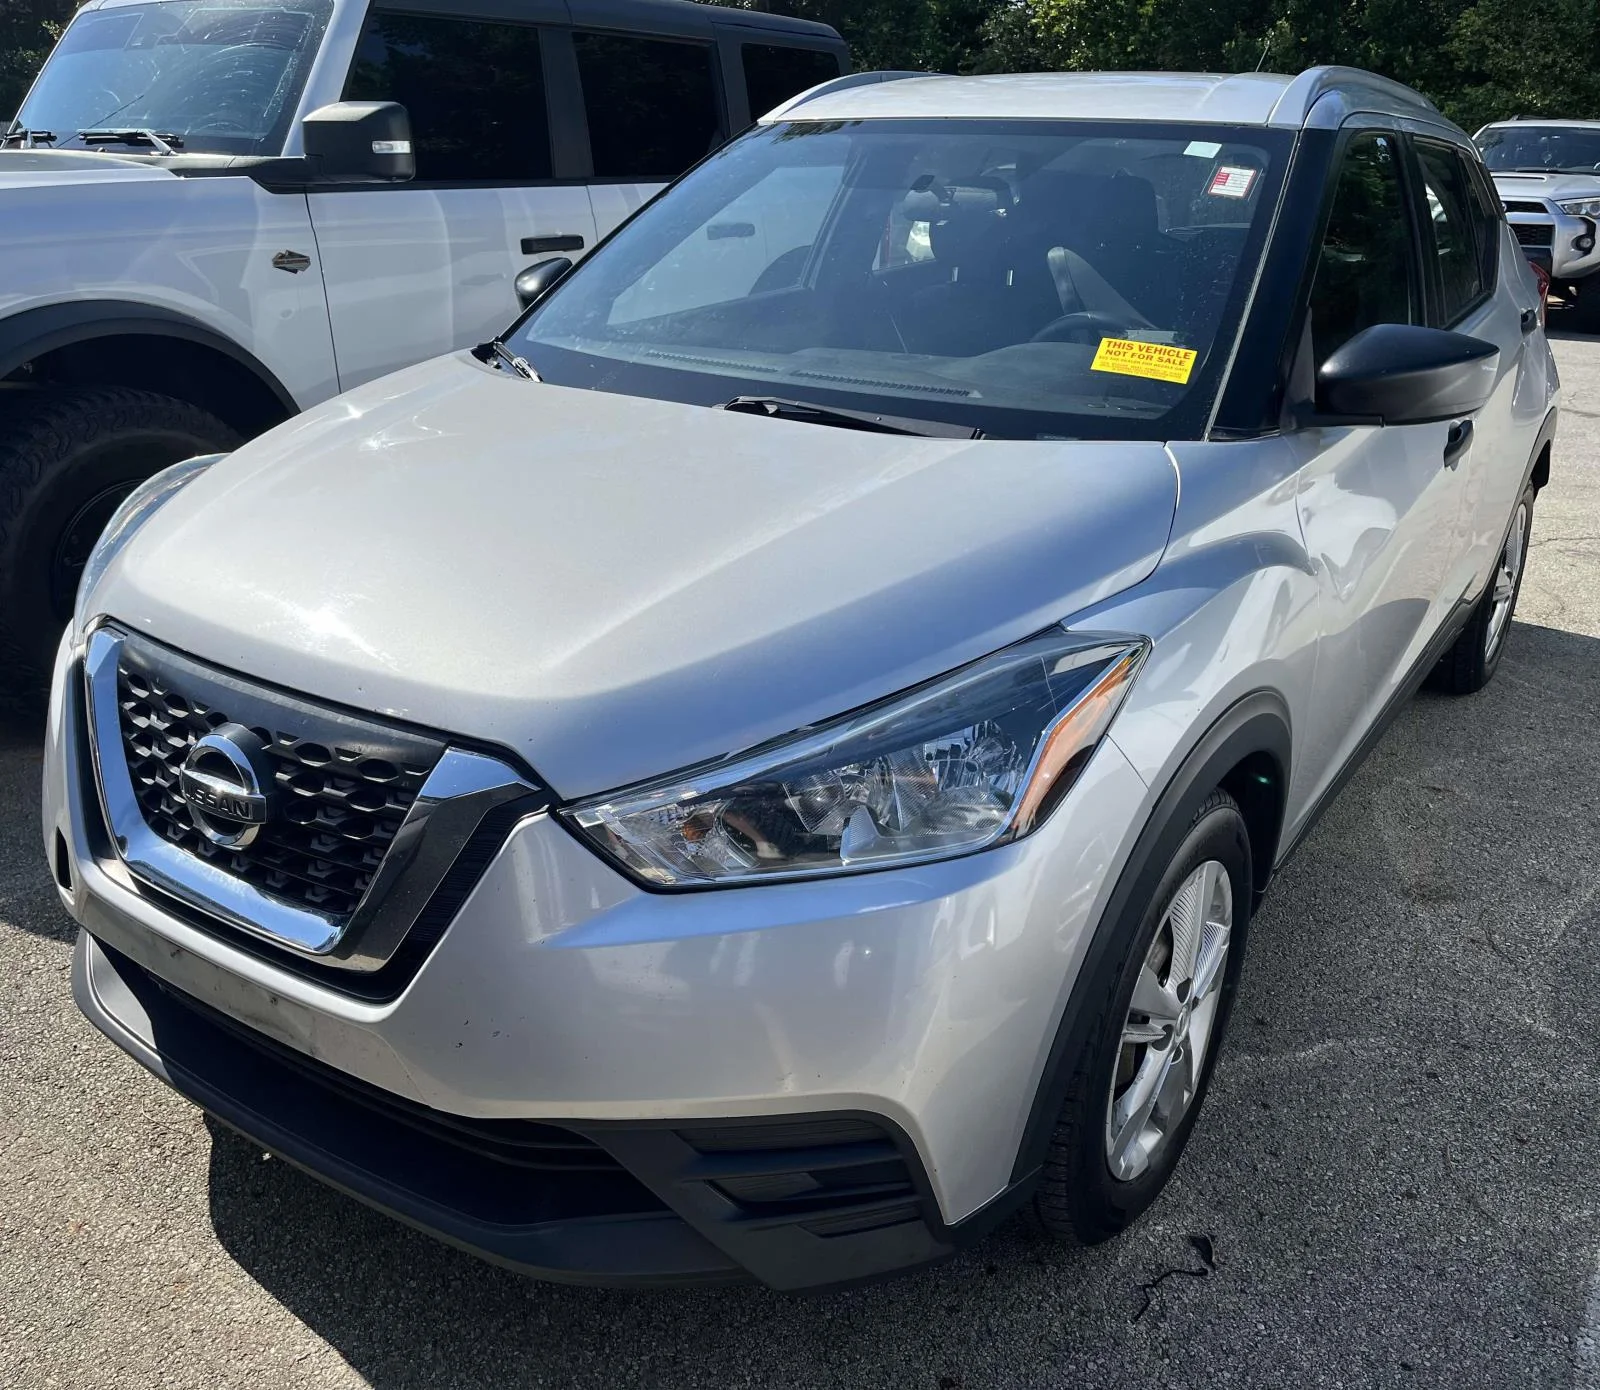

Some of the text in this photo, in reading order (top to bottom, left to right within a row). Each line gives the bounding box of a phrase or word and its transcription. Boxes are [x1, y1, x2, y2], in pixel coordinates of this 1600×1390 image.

[1105, 349, 1129, 357] NOT
[1130, 352, 1154, 361] FOR
[1156, 356, 1185, 367] SALE
[1106, 340, 1193, 360] THIS VEHICLE
[184, 784, 254, 819] NISSAN
